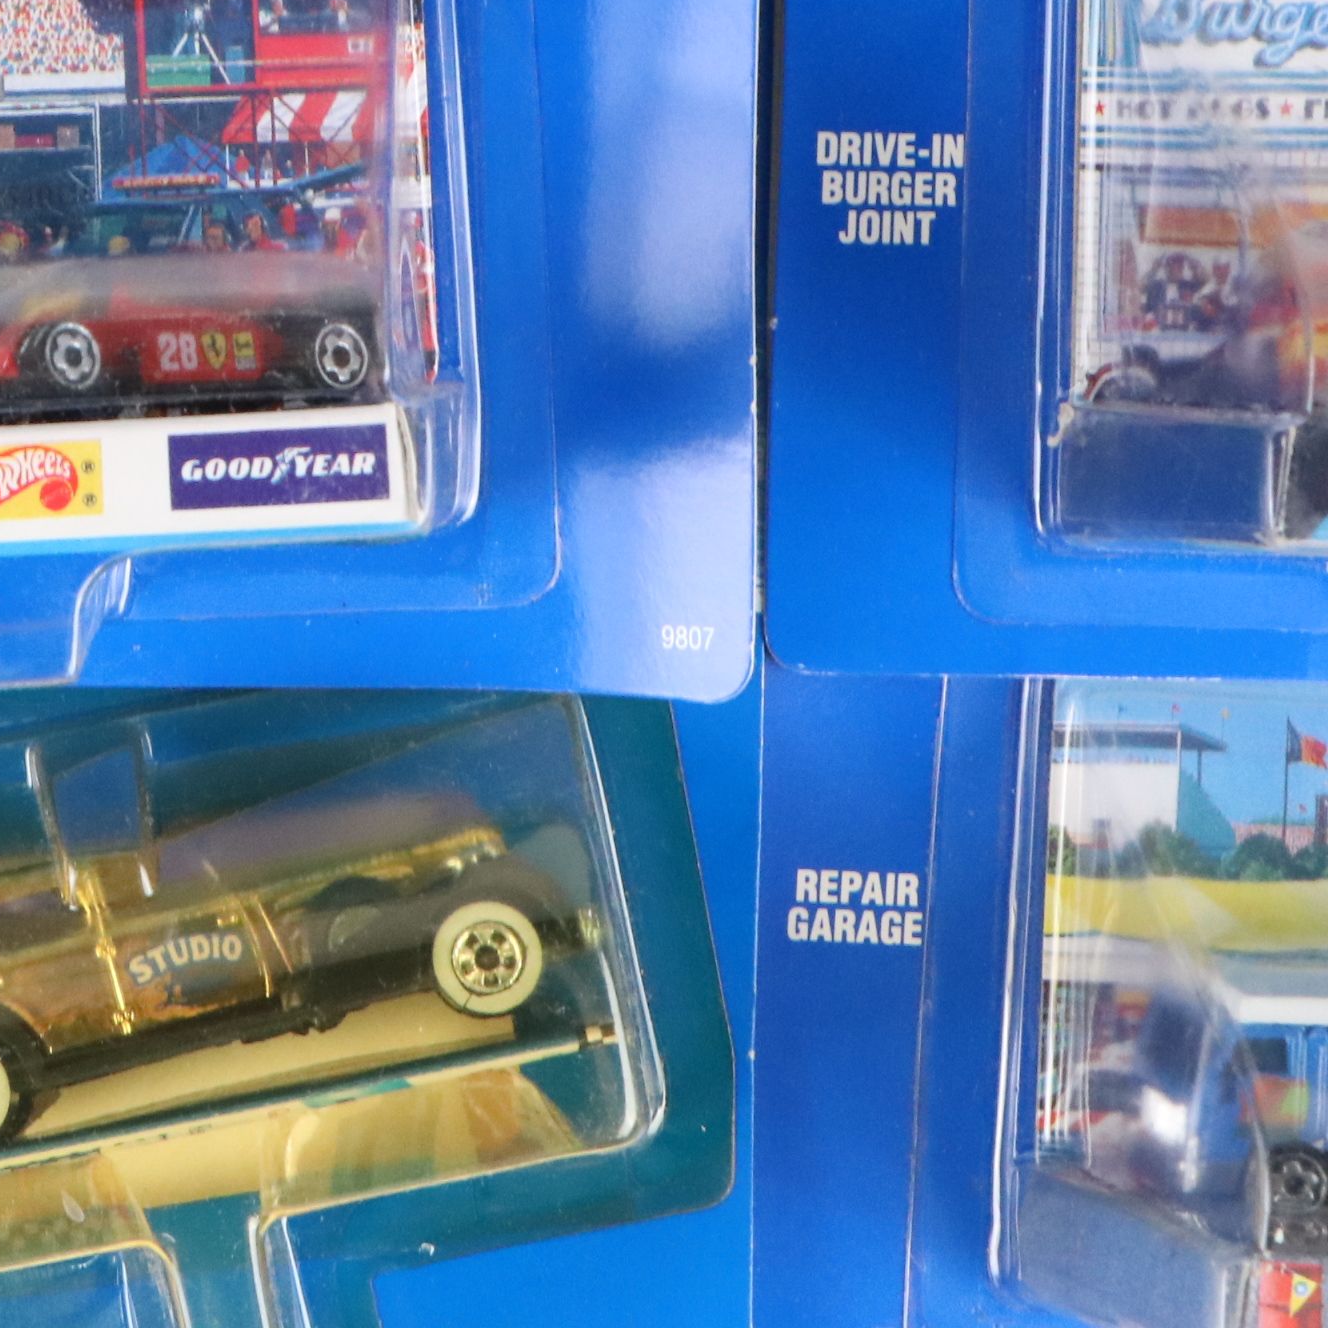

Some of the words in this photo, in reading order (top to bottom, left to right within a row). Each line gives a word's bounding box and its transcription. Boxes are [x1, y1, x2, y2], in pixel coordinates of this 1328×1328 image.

[816, 131, 964, 169] DRIVE-IN
[821, 170, 957, 207] BURGER
[839, 210, 935, 246] JOINT
[158, 331, 198, 371] 28
[660, 624, 713, 652] 9807
[795, 869, 919, 907] REPAIR
[787, 907, 923, 946] GARAGE
[129, 933, 243, 984] STUDIO
